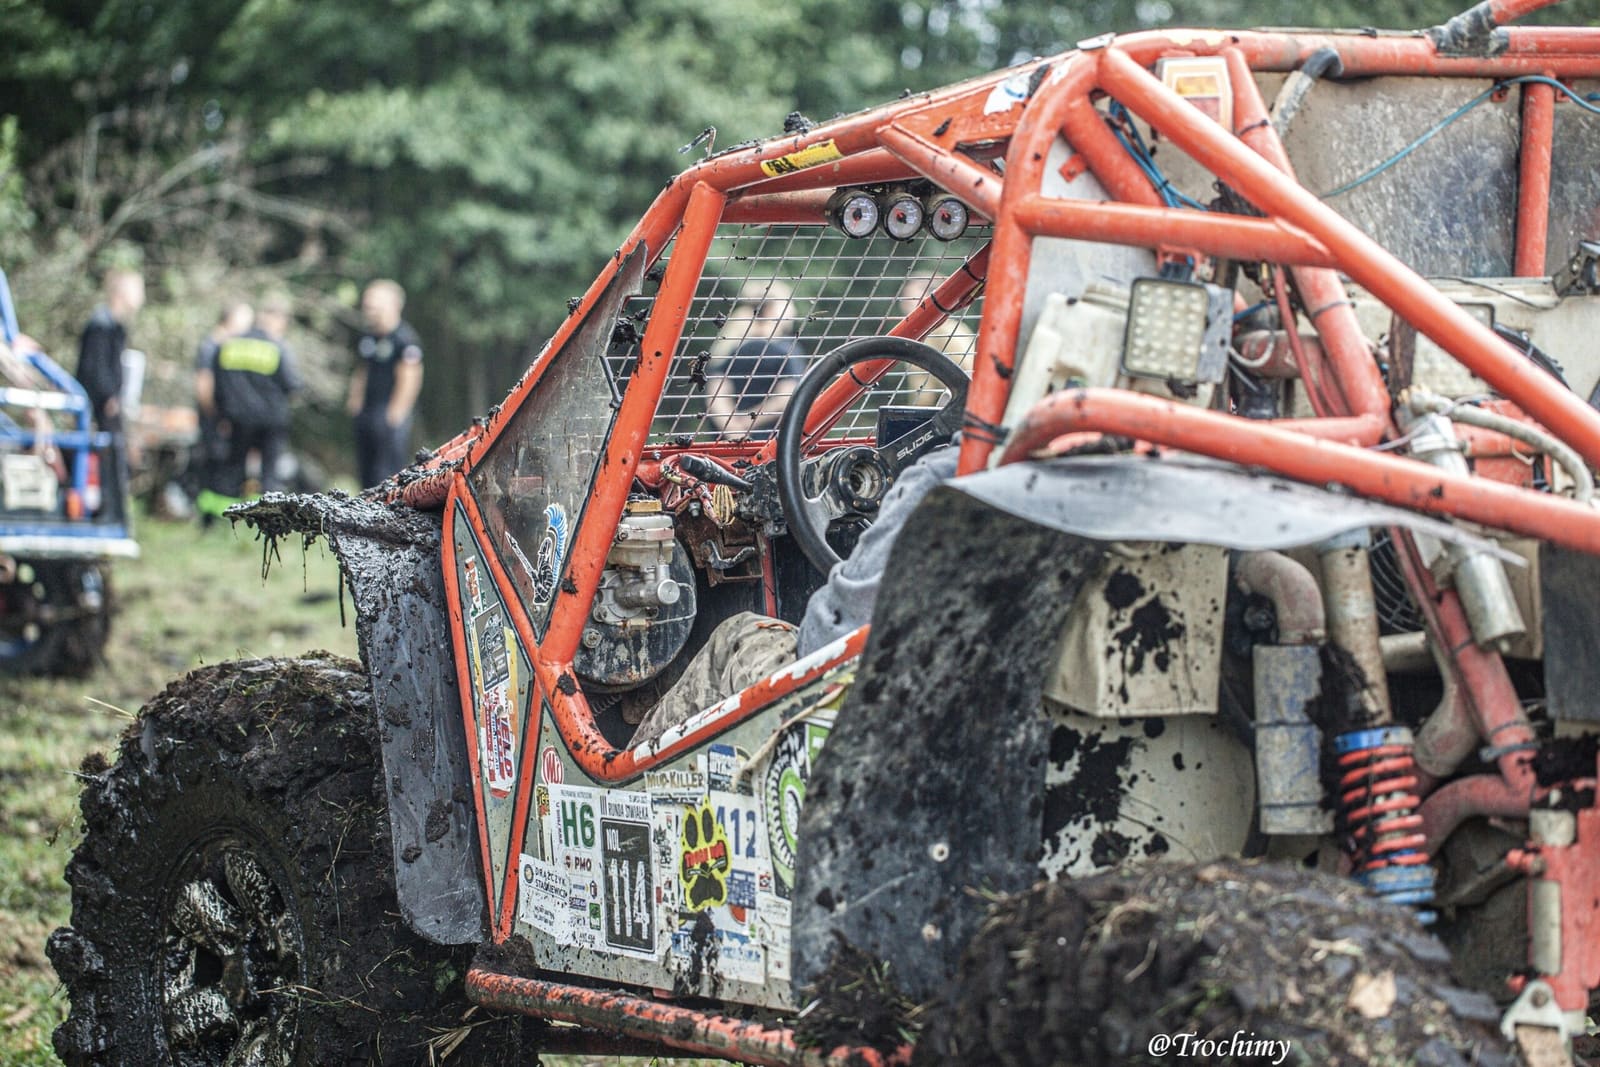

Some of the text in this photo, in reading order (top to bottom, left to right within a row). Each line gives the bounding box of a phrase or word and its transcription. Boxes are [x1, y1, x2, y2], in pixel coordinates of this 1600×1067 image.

[896, 430, 934, 461] SLIDE
[561, 800, 595, 848] H6
[606, 829, 621, 852] NOL
[608, 858, 650, 940] 114
